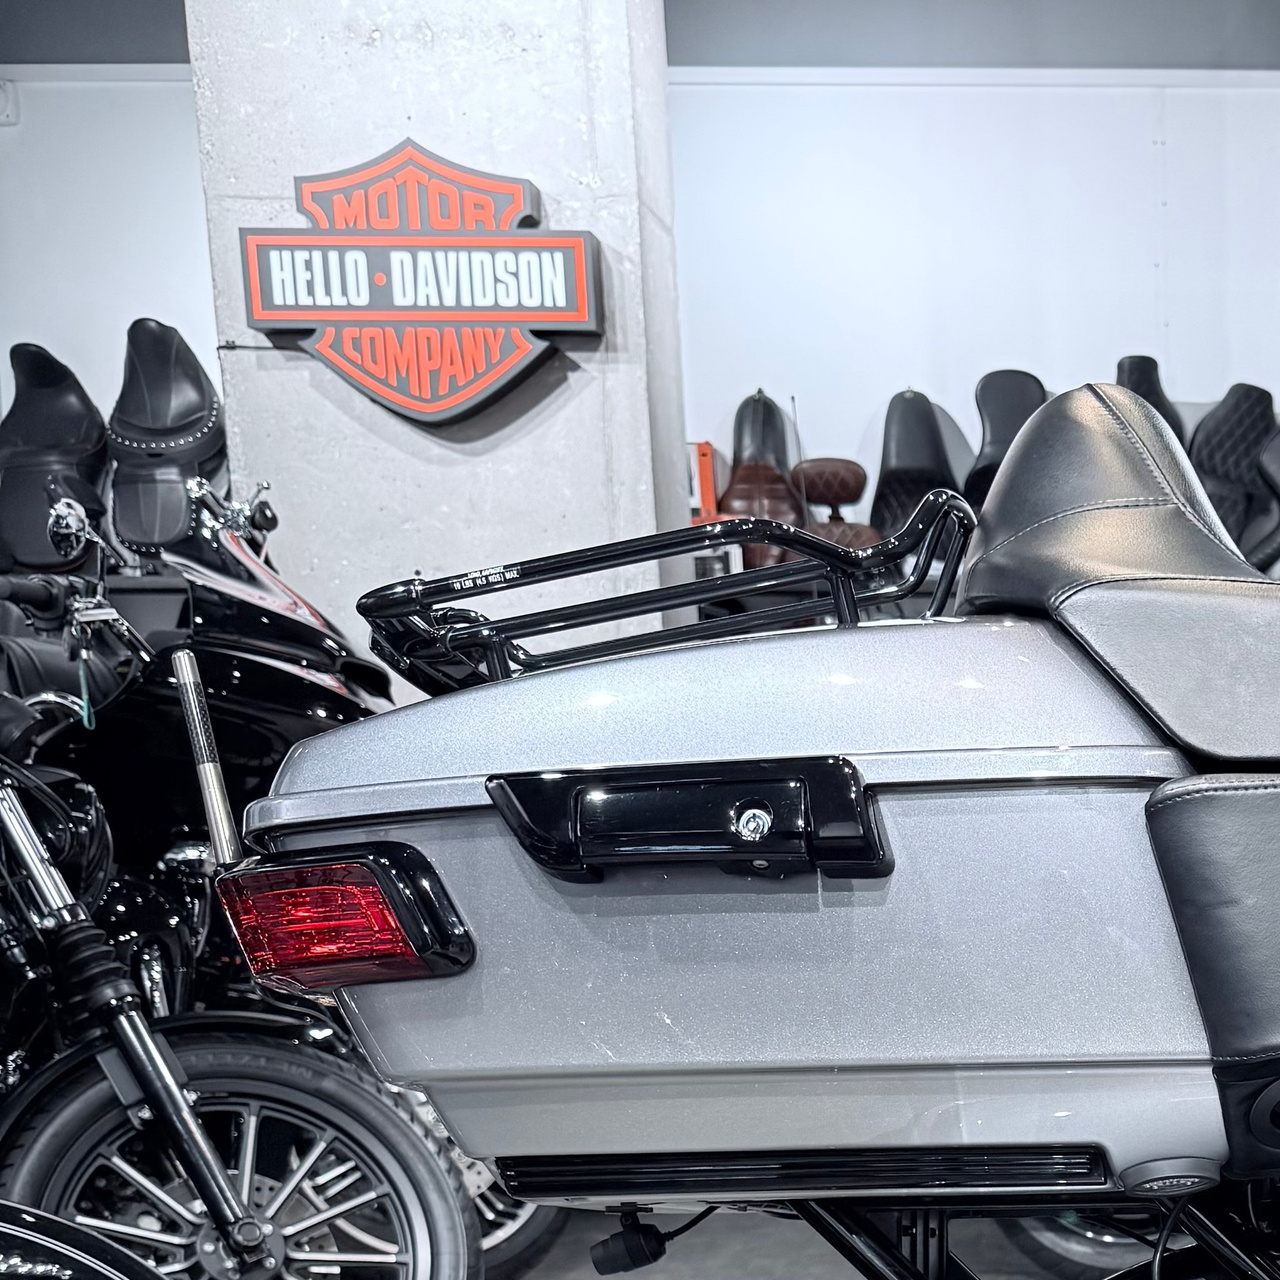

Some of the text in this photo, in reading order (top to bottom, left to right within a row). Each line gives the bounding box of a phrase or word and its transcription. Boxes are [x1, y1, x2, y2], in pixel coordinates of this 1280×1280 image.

[332, 165, 497, 231] MOTOR
[269, 249, 567, 308] HELLO DAVIDSON
[342, 326, 505, 399] COMPANY
